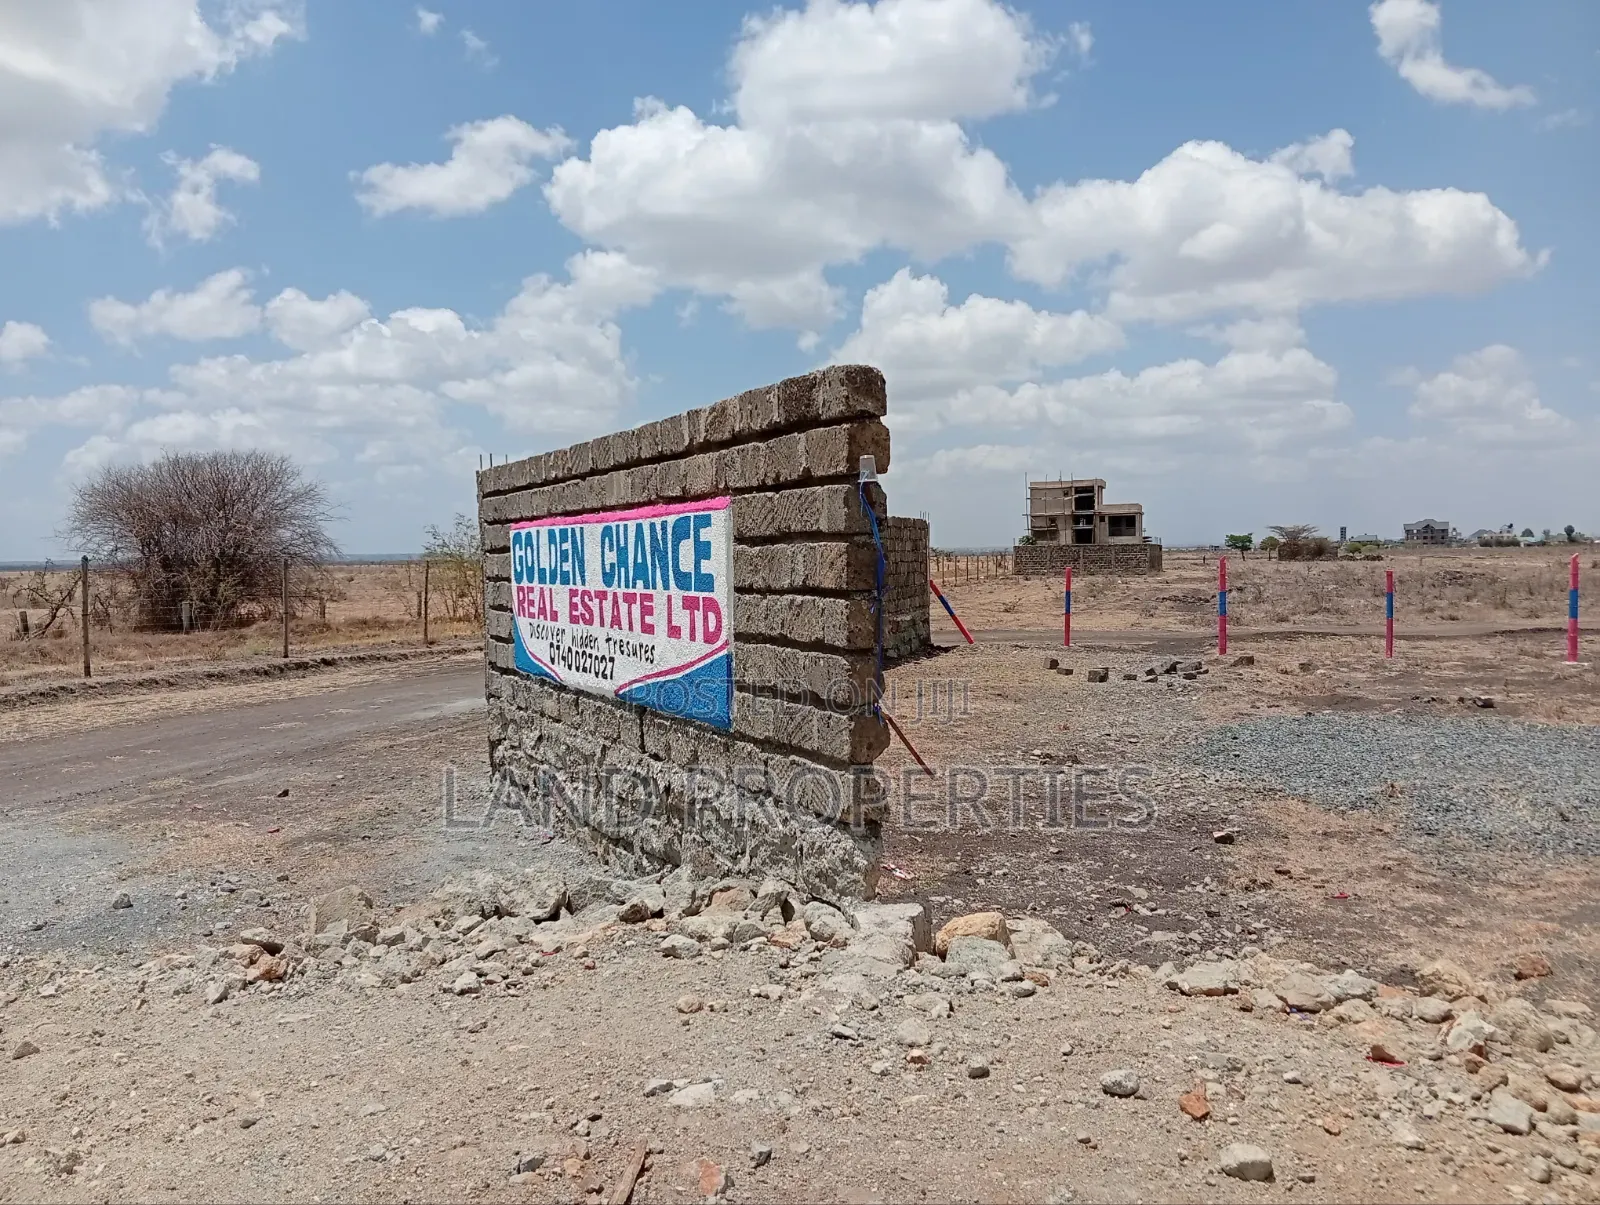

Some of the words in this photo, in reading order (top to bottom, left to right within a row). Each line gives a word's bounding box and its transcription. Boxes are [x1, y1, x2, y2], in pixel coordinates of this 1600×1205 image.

[512, 526, 586, 586] GOLDEN
[600, 513, 715, 593] CHANCE
[516, 586, 559, 622] REAL
[569, 588, 655, 635] ESTATE
[666, 594, 723, 645] LTD
[549, 641, 616, 680] 0740027027
[571, 628, 600, 652] hidden
[605, 634, 656, 664] tresures
